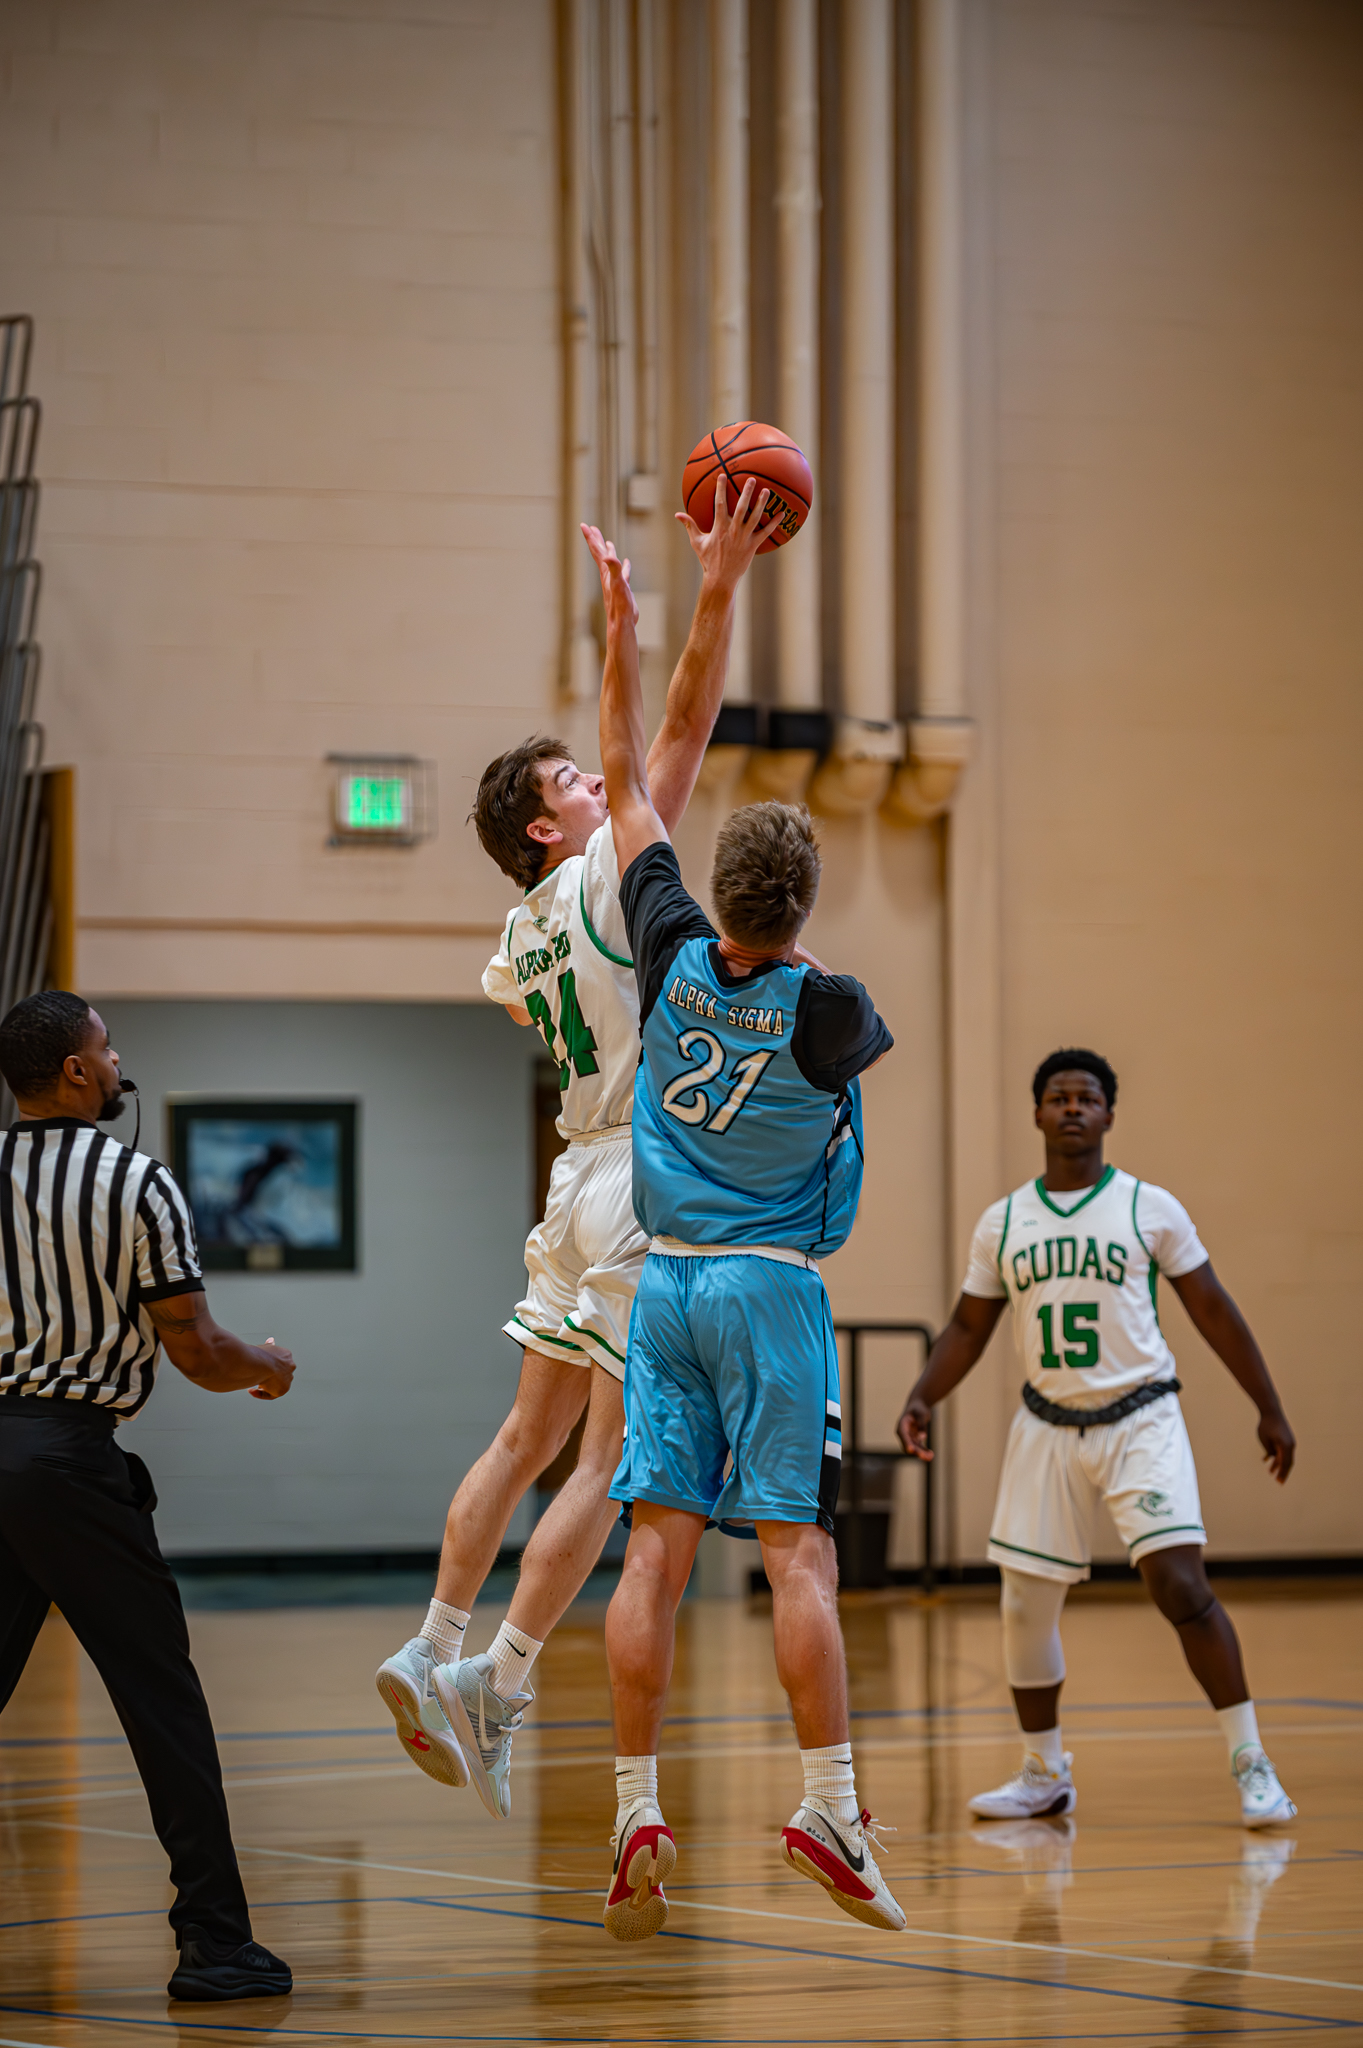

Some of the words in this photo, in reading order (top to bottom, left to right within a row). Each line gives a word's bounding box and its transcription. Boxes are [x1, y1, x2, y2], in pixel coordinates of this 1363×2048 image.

[515, 947, 554, 986] ALPHA
[524, 966, 600, 1092] 24
[667, 975, 717, 1020] ALPHA
[727, 1005, 783, 1037] SIGMA
[661, 1026, 779, 1136] 21
[1012, 1235, 1128, 1292] CUDAS
[1037, 1303, 1099, 1369] 15
